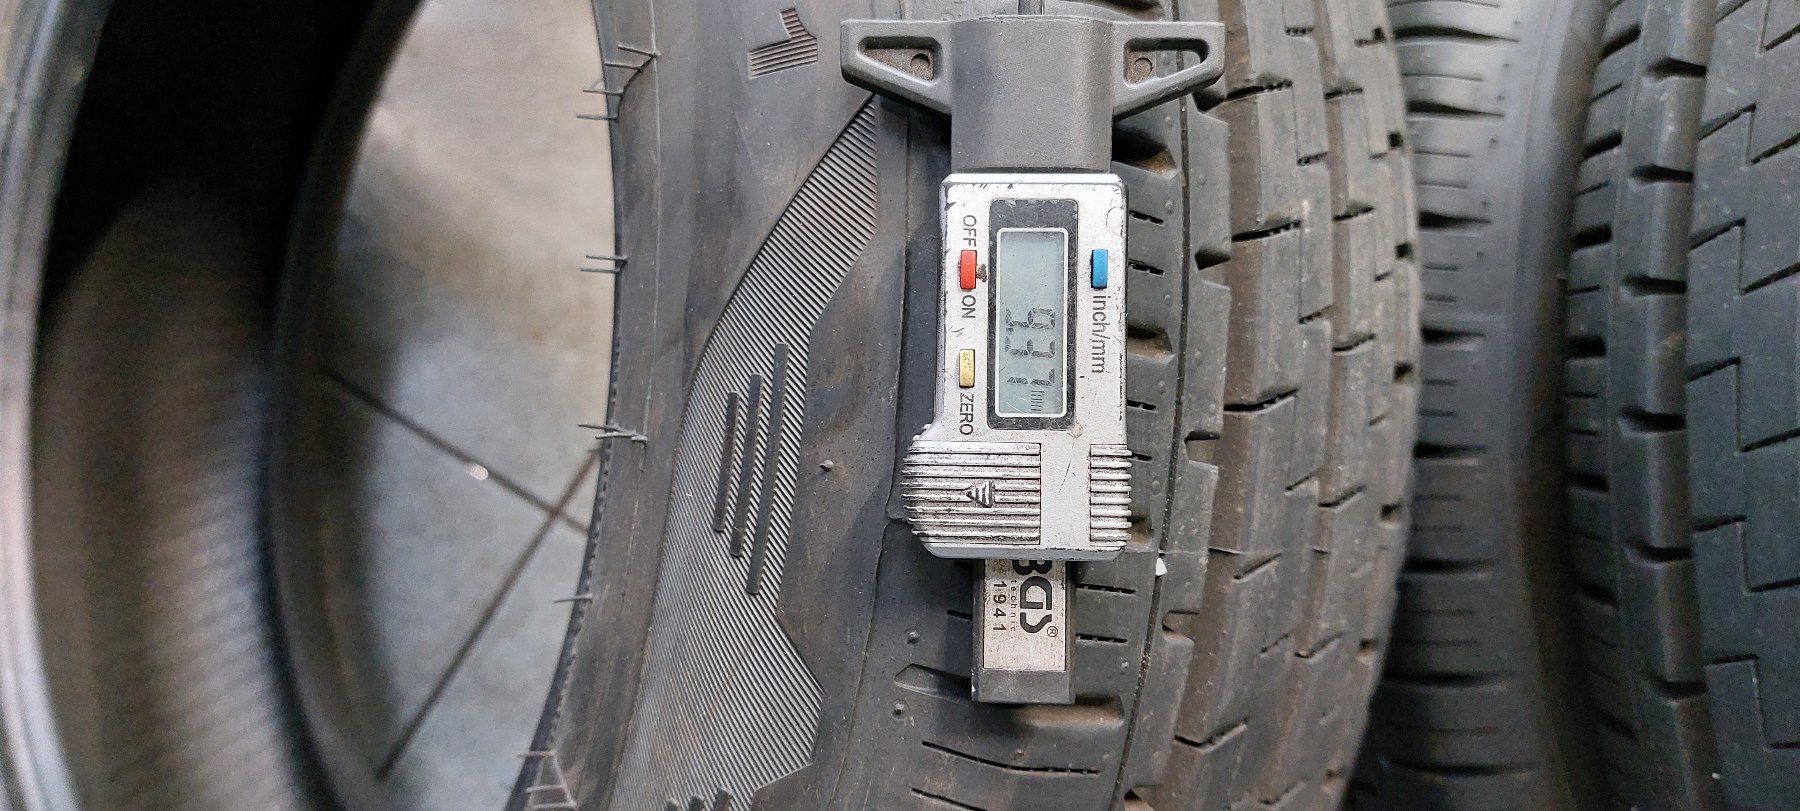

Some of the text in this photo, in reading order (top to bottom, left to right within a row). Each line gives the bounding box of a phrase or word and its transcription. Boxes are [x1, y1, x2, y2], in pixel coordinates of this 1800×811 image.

[961, 213, 977, 248] OFF
[961, 294, 977, 319] ON
[1091, 294, 1111, 374] inch/mm
[958, 392, 974, 436] ZERO
[992, 580, 1007, 632] 1941
[1010, 579, 1018, 632] technic
